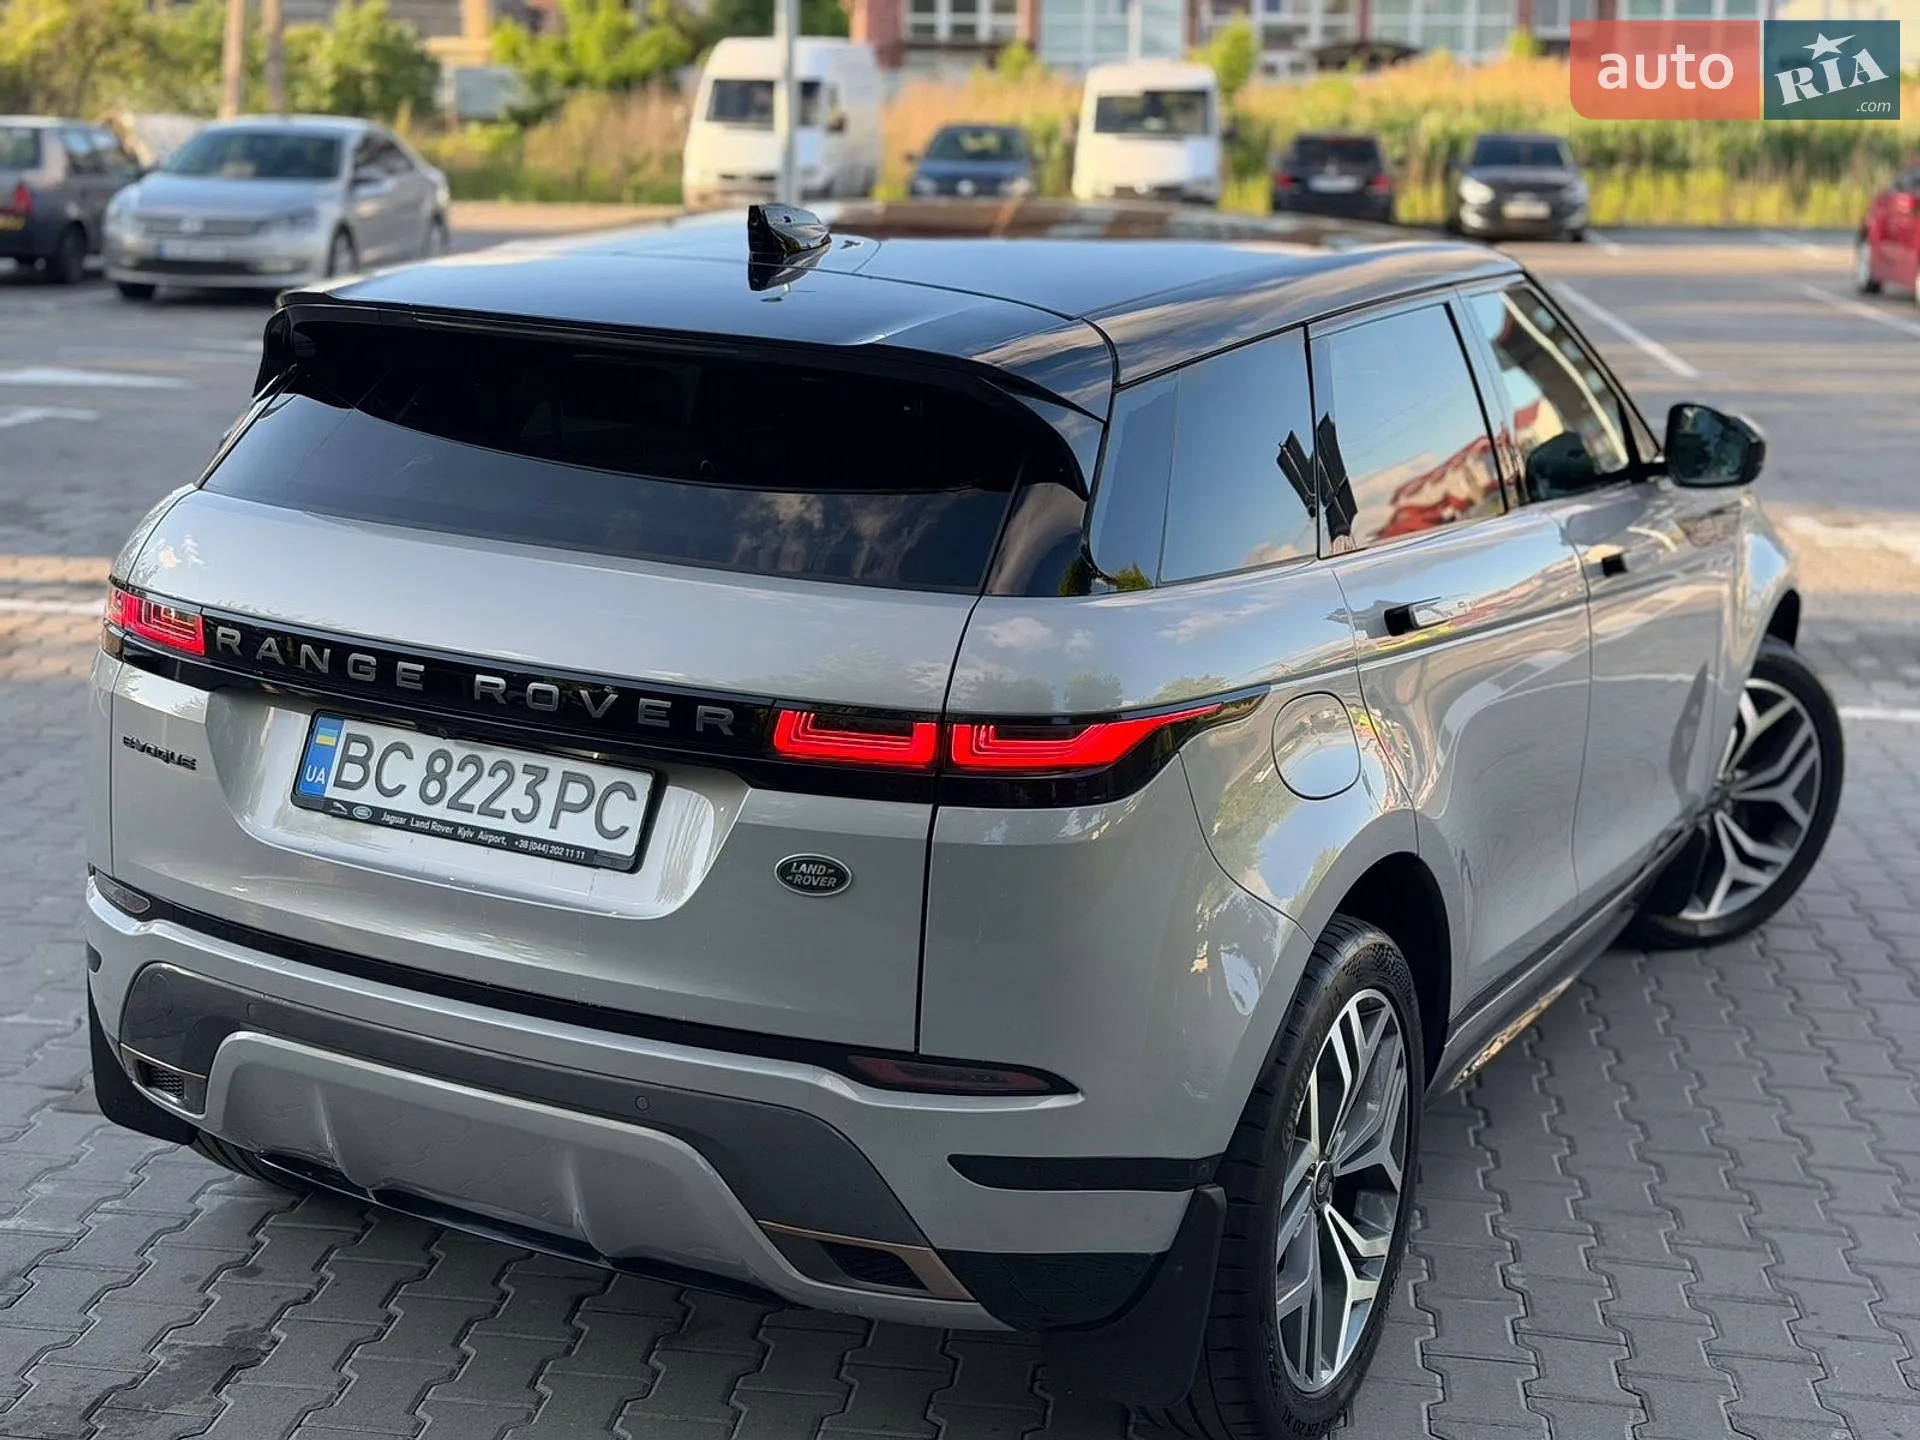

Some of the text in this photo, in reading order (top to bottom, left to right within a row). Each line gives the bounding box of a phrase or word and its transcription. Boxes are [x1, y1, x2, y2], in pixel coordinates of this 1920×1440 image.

[215, 625, 735, 736] RANGE ROVER
[305, 764, 326, 786] UA
[333, 732, 638, 840] BC 8223 PC
[381, 810, 407, 826] Jaguar
[410, 817, 430, 830] Land
[431, 822, 454, 834] Rover
[457, 825, 475, 839] Kyiv
[477, 830, 507, 846] Airport,
[514, 838, 529, 849] +38
[528, 841, 549, 854] (044)
[549, 845, 565, 856] 202
[790, 862, 837, 887] LAND ROVER
